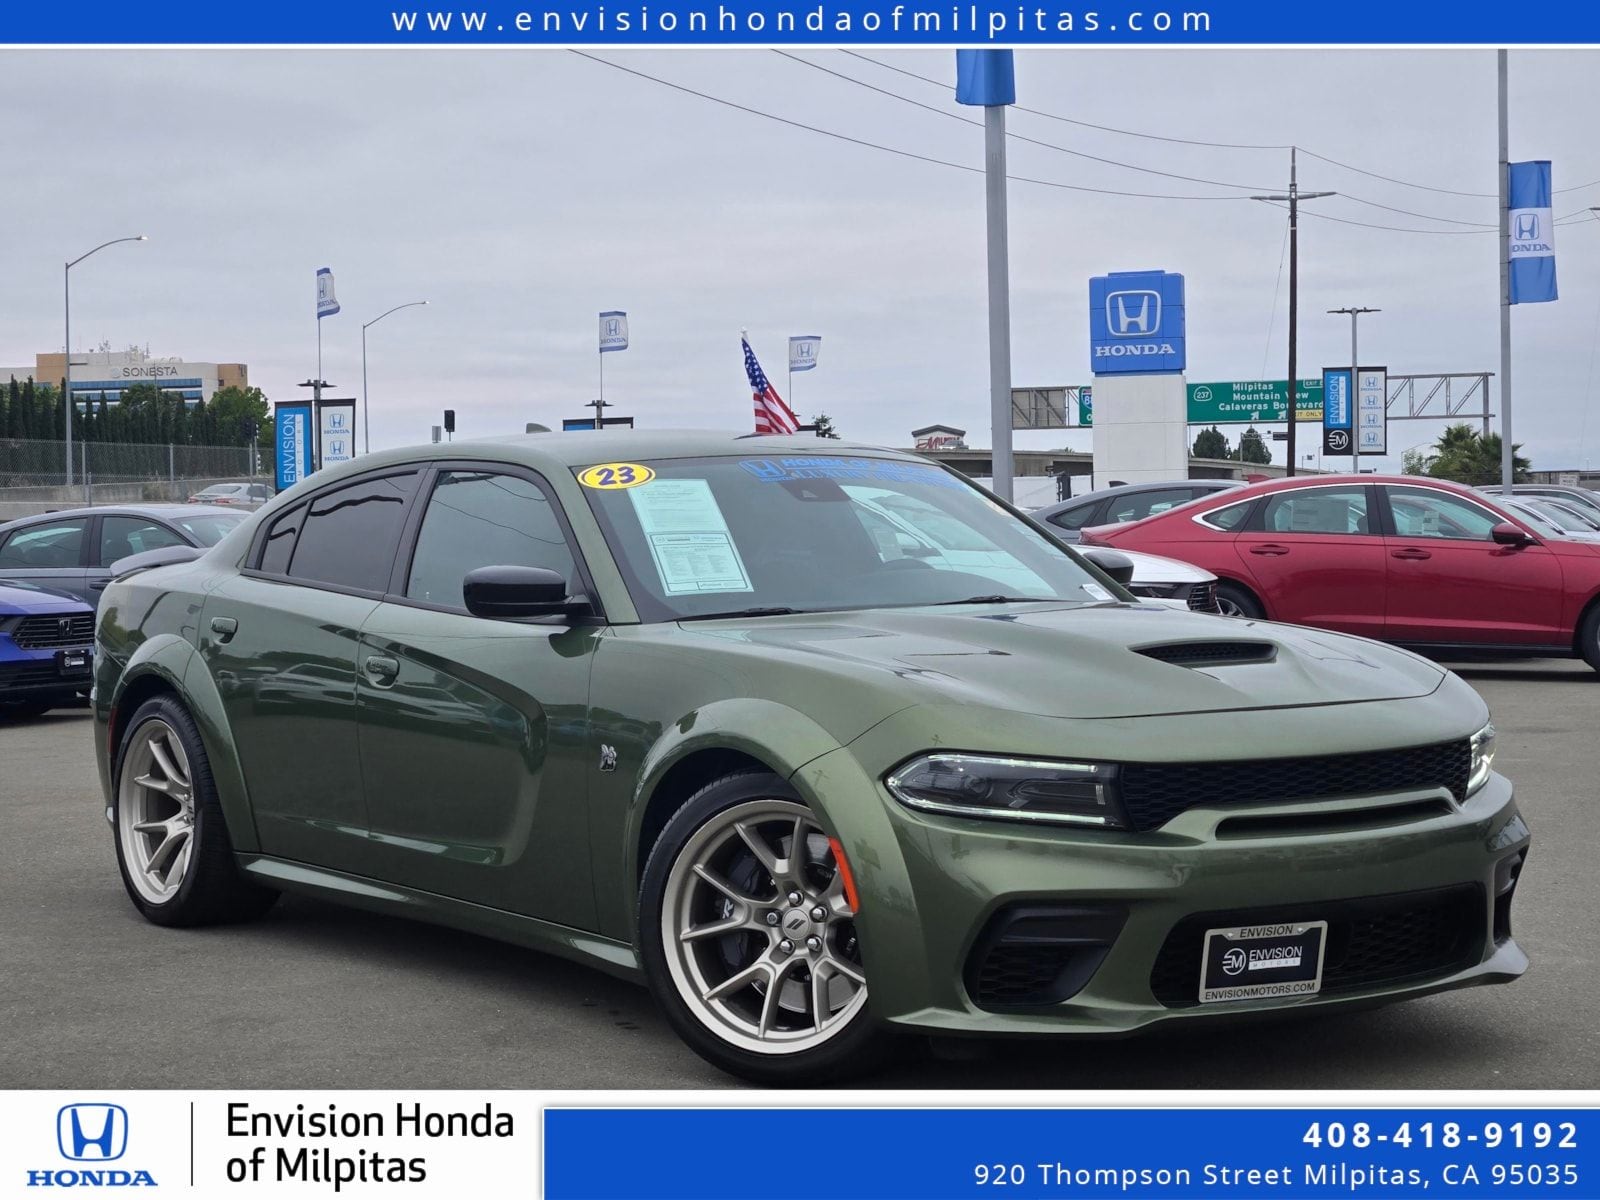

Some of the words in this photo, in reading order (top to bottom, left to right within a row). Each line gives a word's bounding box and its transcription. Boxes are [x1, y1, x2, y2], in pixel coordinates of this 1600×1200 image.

[1512, 243, 1552, 252] ONDA
[1095, 343, 1176, 357] HONDA
[122, 366, 179, 377] SONESTA
[1232, 382, 1274, 392] Milpitas
[1196, 391, 1210, 399] 237
[1232, 391, 1281, 401] Mountain
[1329, 375, 1339, 424] ENVISION
[1218, 402, 1268, 411] Calaveras
[283, 414, 296, 483] ENVISION
[595, 466, 636, 486] 23
[1240, 925, 1294, 938] ENVISION
[1249, 946, 1302, 960] ENVISION
[1205, 983, 1315, 1000] ENVISIONMOTORS.COM
